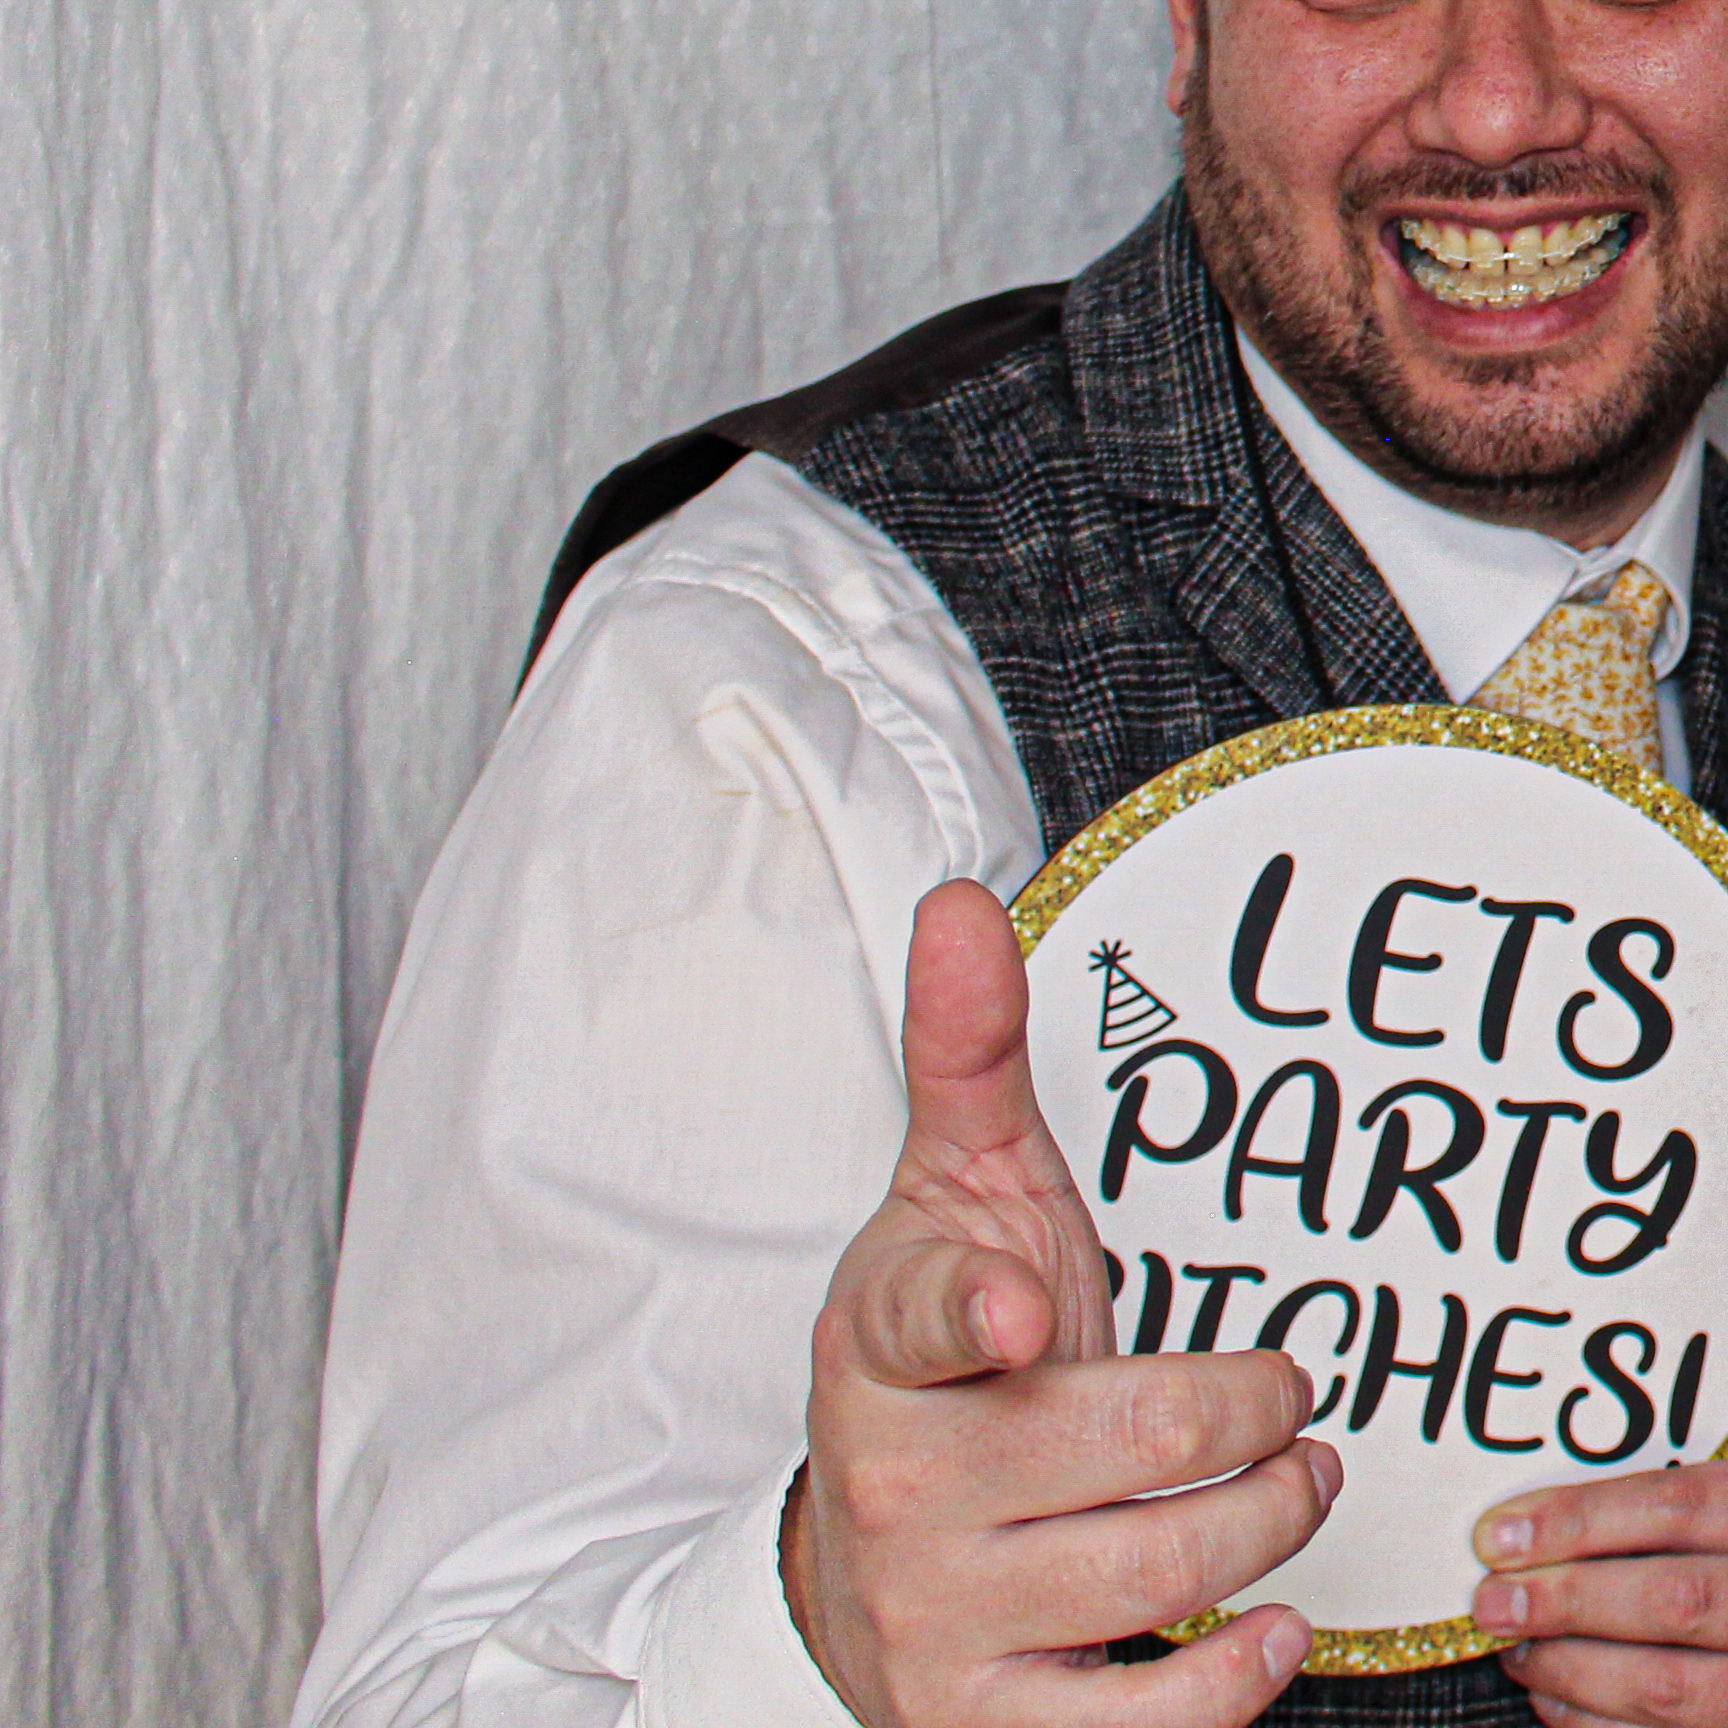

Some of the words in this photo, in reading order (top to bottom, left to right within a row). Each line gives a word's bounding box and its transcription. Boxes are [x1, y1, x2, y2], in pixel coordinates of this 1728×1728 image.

[1228, 853, 1676, 1081] LETS
[1099, 1039, 1698, 1276] PARTY
[1102, 1246, 1708, 1469] ITCHES!
